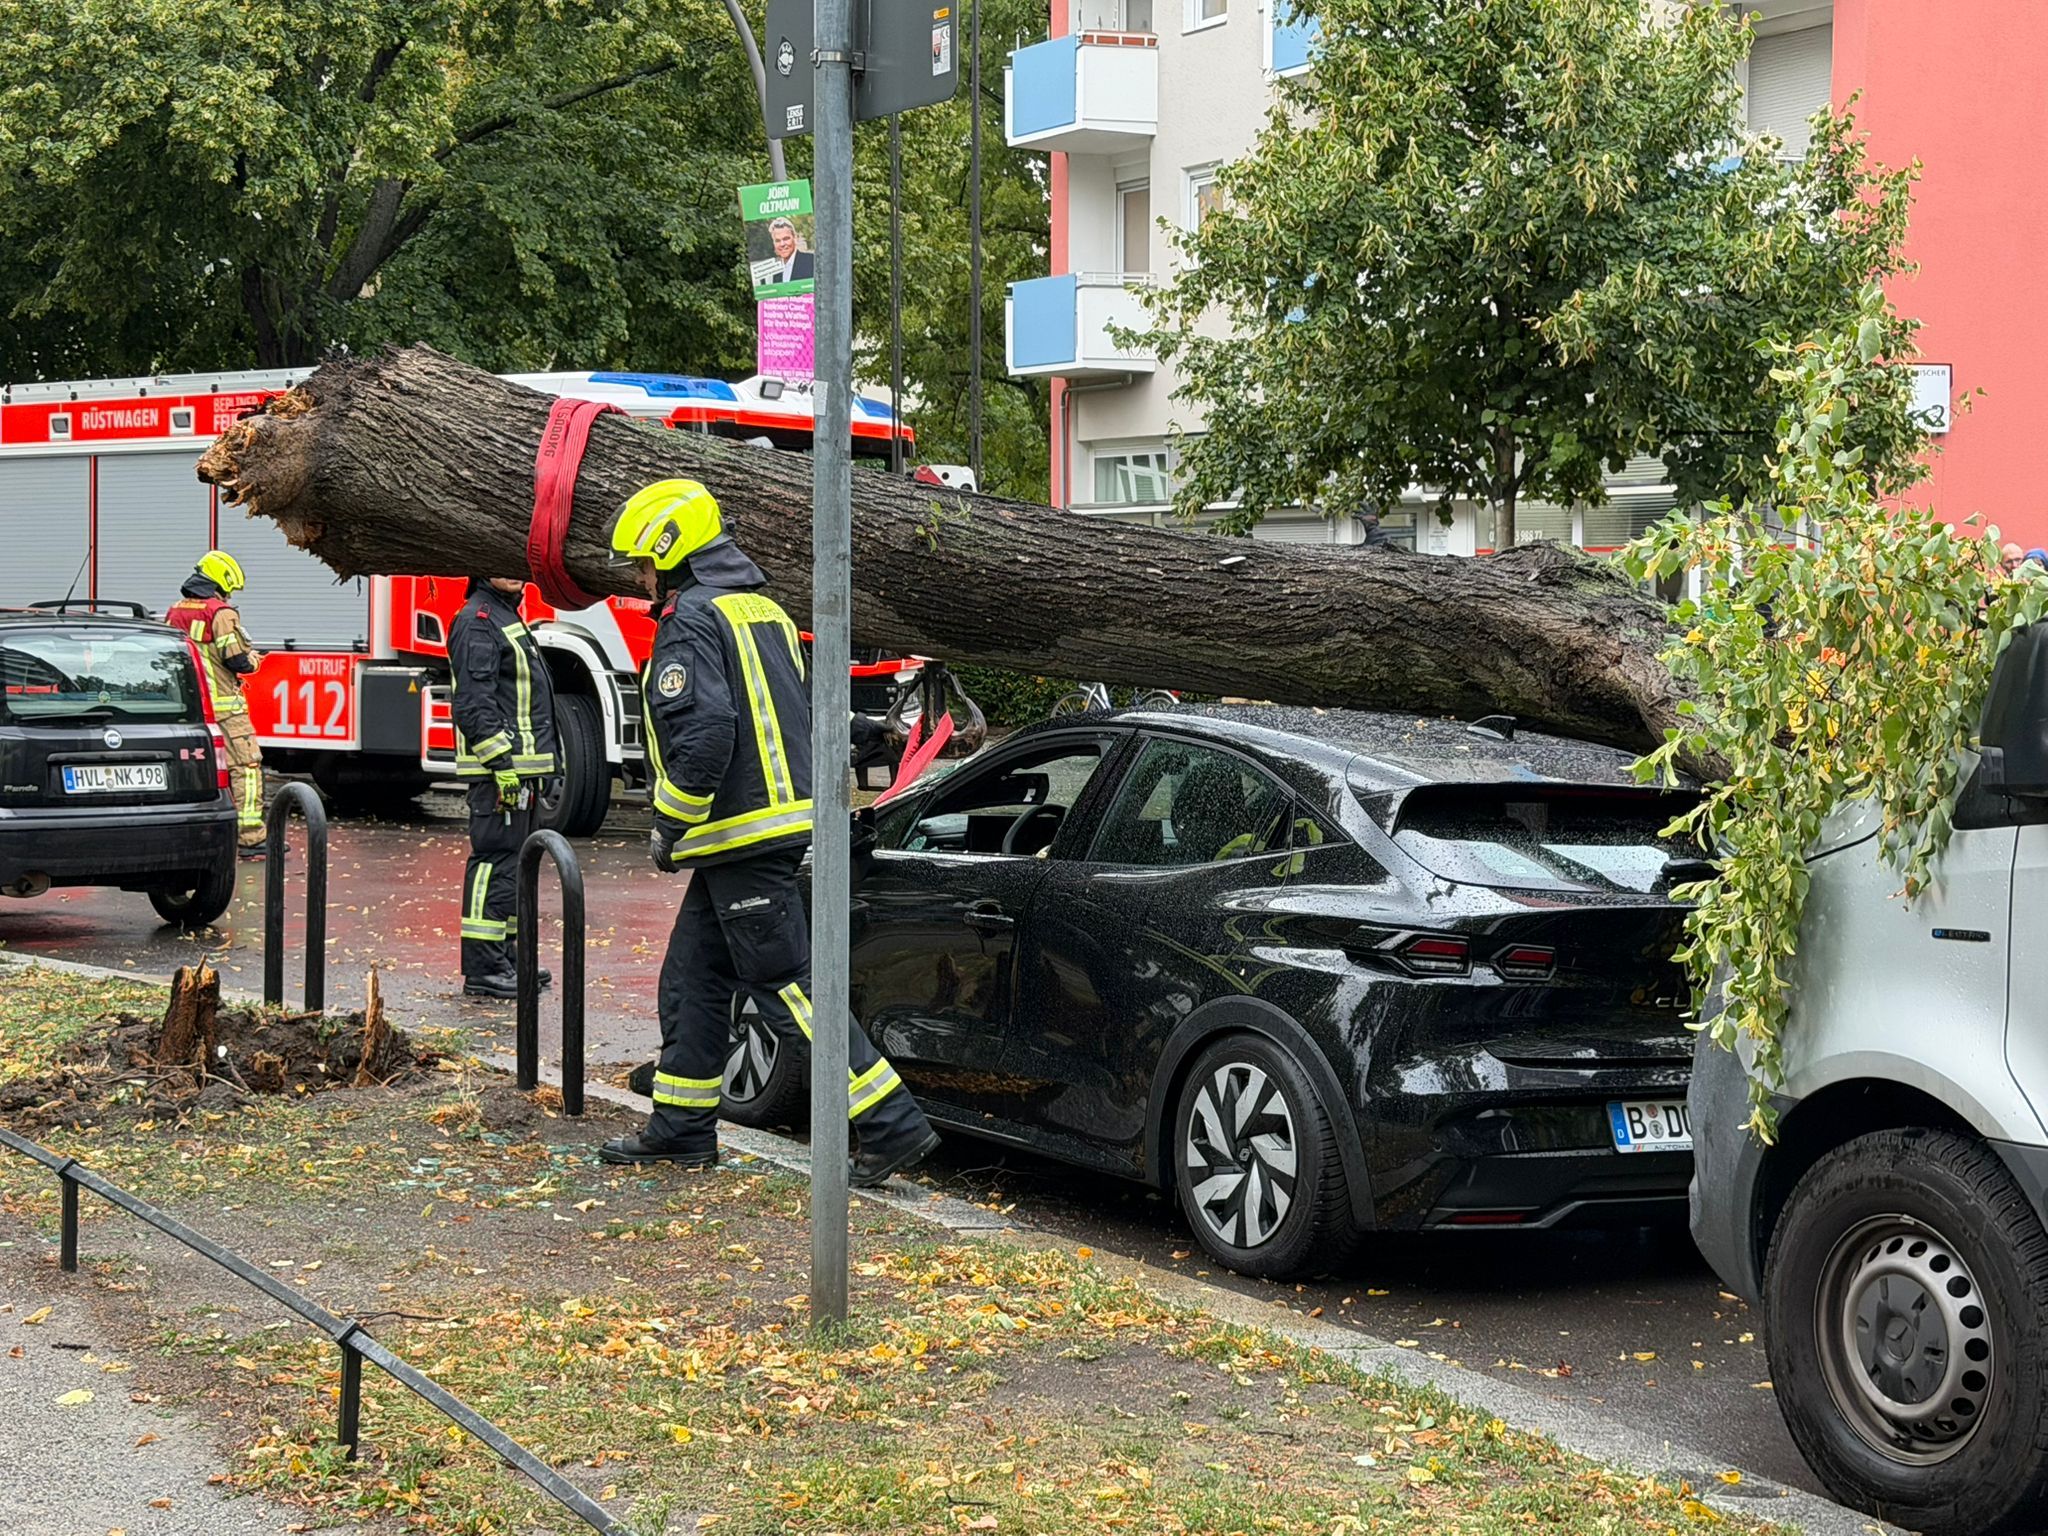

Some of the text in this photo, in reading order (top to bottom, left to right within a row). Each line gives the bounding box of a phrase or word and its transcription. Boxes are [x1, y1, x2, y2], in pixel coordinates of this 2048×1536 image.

[767, 184, 790, 200] JÖRN
[760, 198, 800, 214] OLTMANN
[81, 406, 159, 430] RÜSTWAGEN
[300, 658, 347, 677] NOTRUF
[272, 679, 347, 737] 112
[74, 769, 104, 787] HVL
[114, 768, 134, 785] NK
[136, 767, 163, 785] 198
[1626, 1106, 1648, 1139] B
